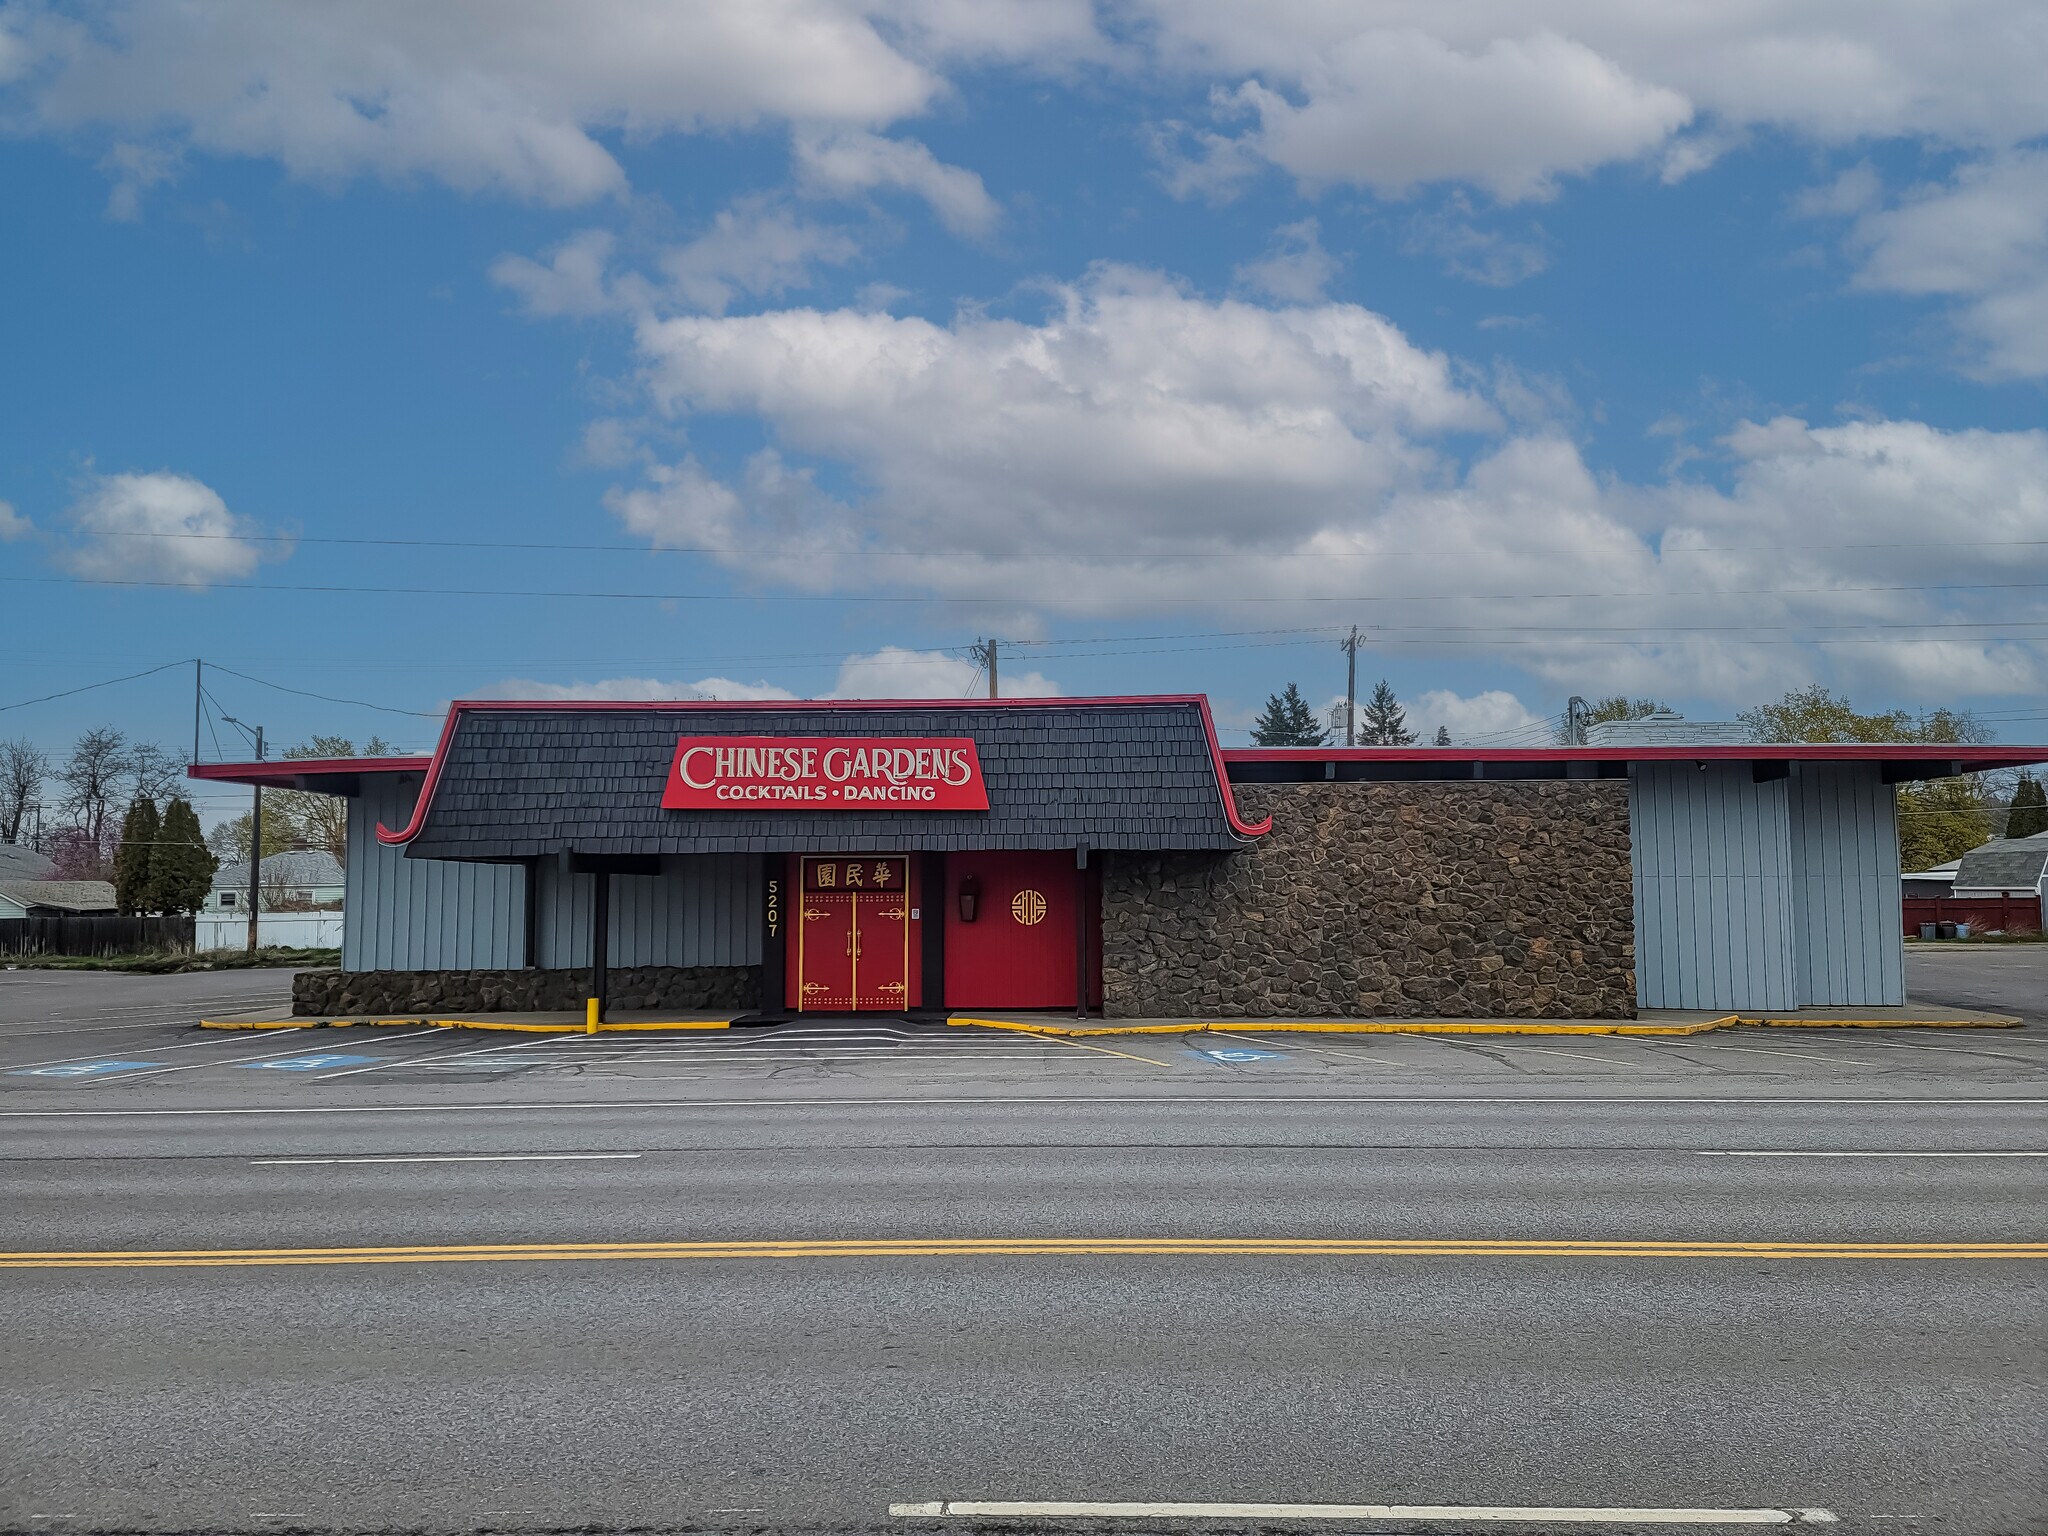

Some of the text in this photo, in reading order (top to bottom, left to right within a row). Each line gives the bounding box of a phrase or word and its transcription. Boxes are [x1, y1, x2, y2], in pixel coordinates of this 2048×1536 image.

[679, 746, 972, 789] CHINESE GARDENS
[715, 785, 936, 801] COCKTAILS DANCING
[768, 880, 778, 937] 5207
